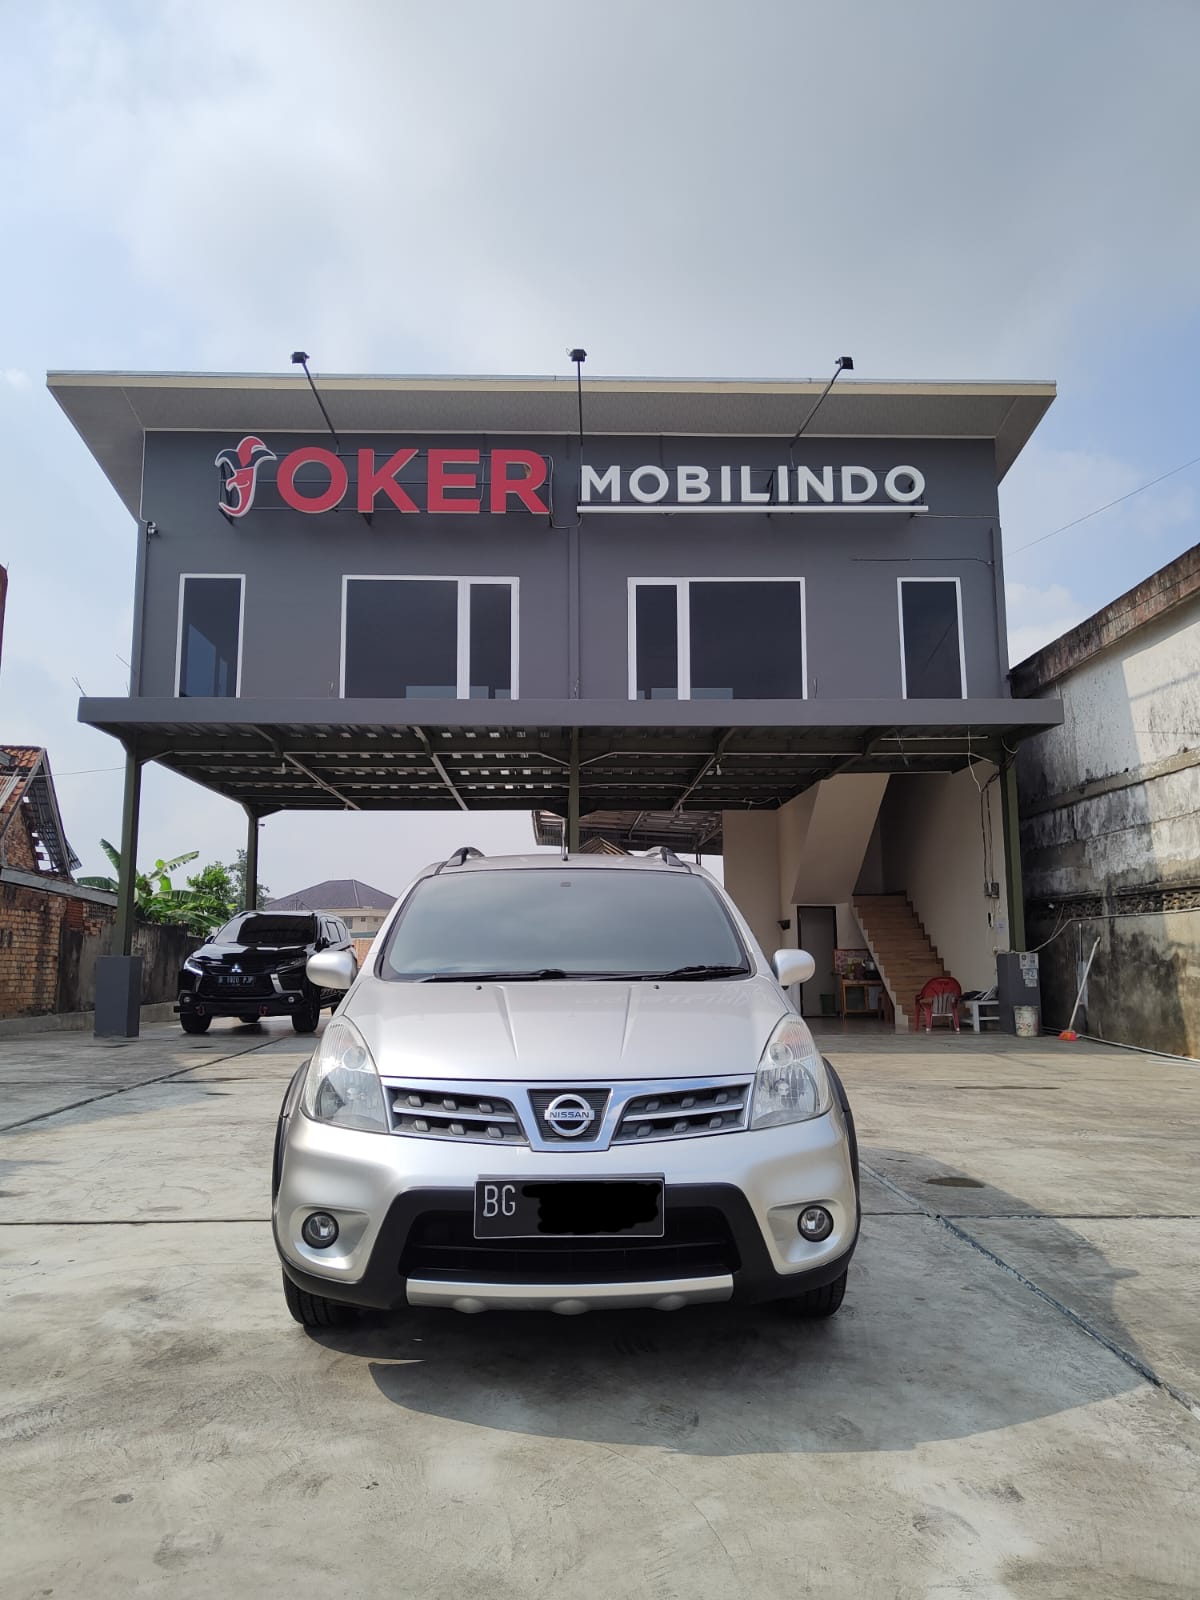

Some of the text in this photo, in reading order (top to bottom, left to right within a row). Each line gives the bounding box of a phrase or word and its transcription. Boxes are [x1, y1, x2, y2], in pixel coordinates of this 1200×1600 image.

[580, 464, 926, 503] MOBILINDO
[549, 1111, 590, 1119] NISSAN
[483, 1185, 516, 1217] BG
